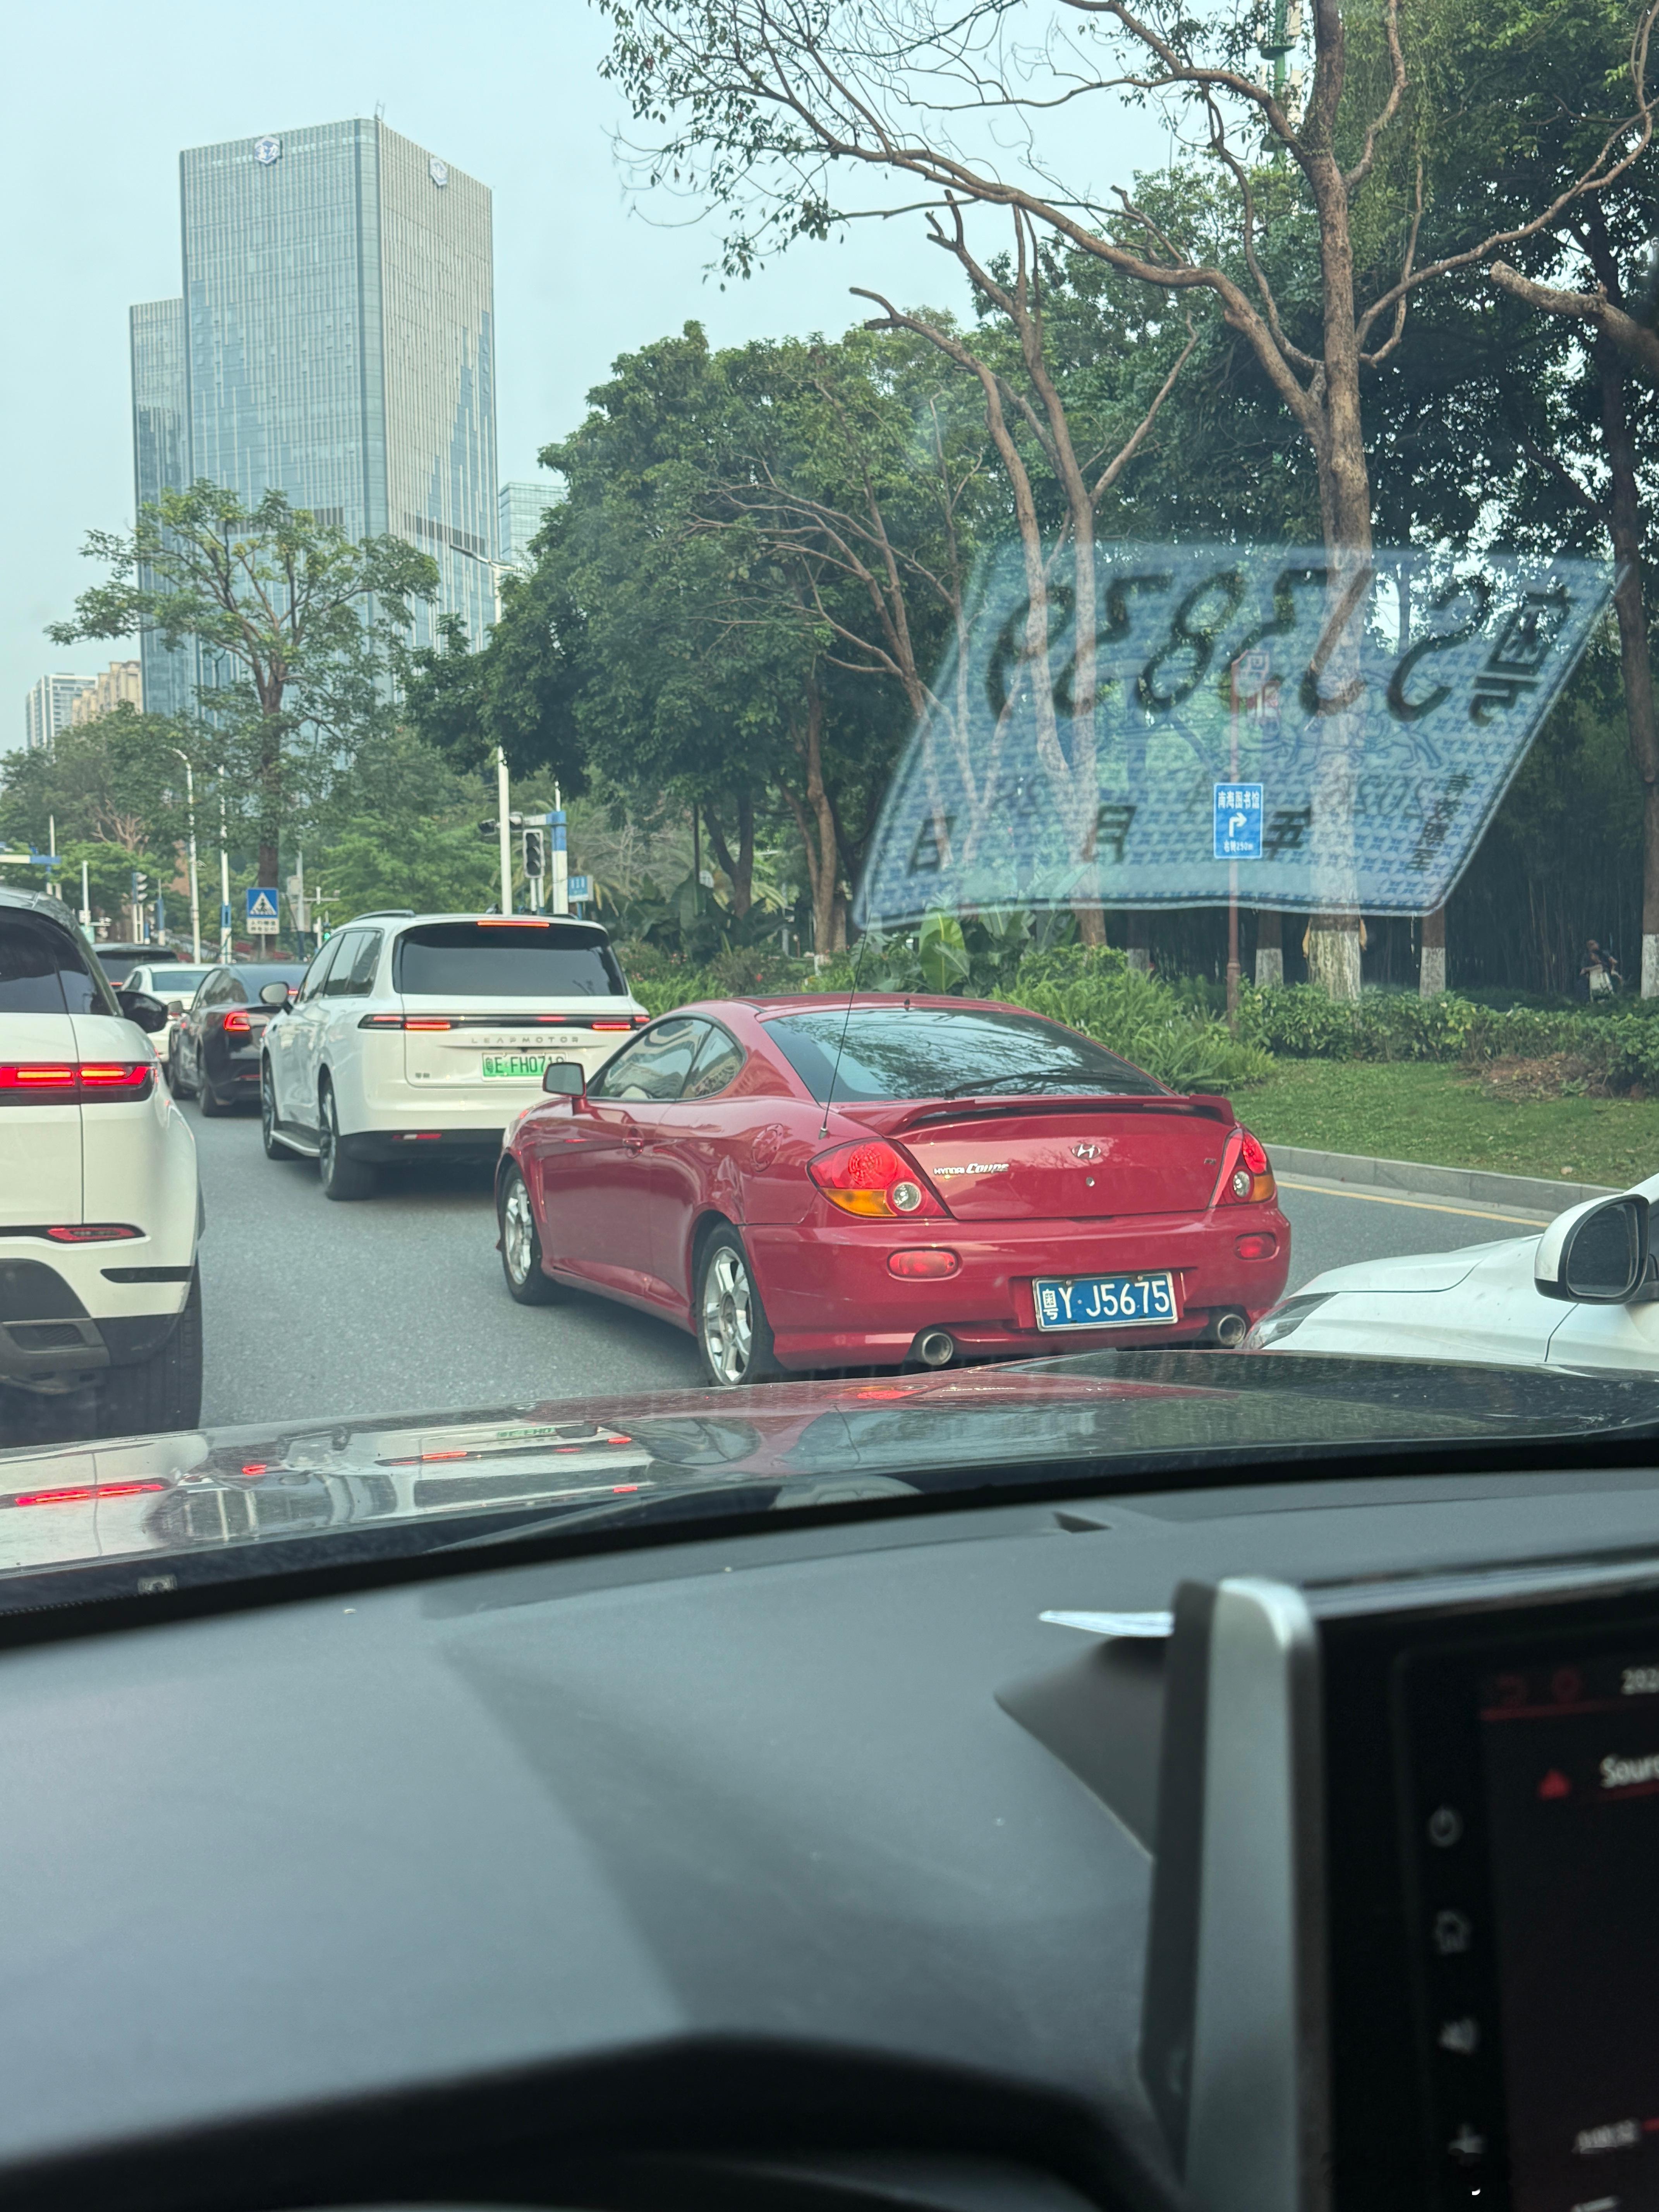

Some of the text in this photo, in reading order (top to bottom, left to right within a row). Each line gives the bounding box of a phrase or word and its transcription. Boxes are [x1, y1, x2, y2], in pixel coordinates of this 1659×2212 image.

[1218, 791, 1260, 809] 南海图书馆
